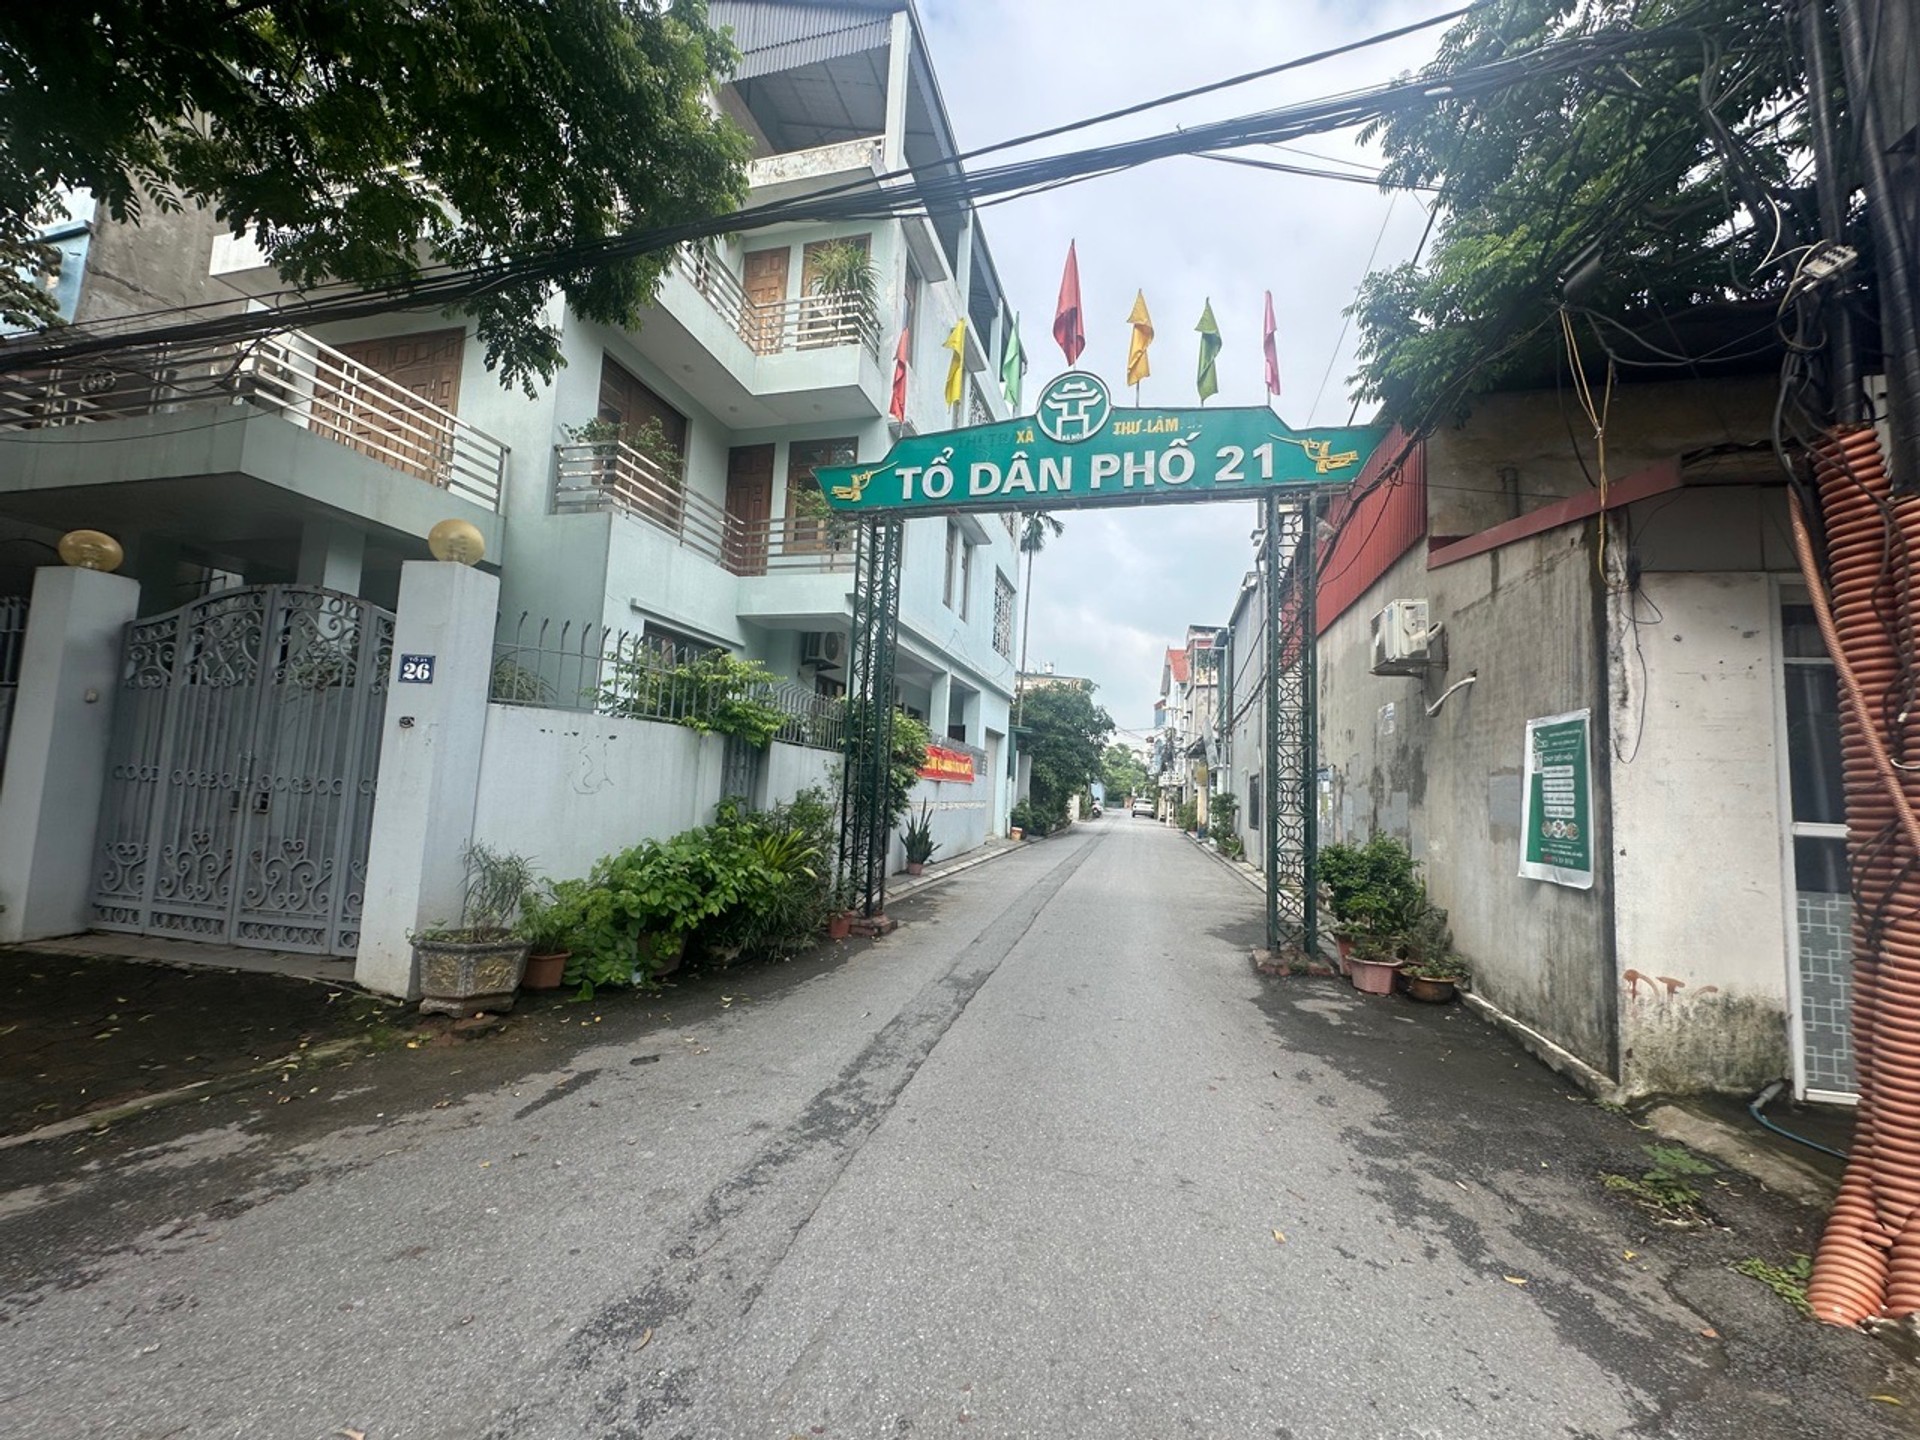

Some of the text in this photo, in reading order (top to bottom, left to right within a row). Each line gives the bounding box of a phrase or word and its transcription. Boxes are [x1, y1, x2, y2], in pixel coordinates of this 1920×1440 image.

[1016, 426, 1035, 444] XÃ
[1112, 419, 1142, 435] THƯ
[895, 431, 1274, 500] TỔ DÂN PHỐ 21
[402, 662, 430, 680] 26
